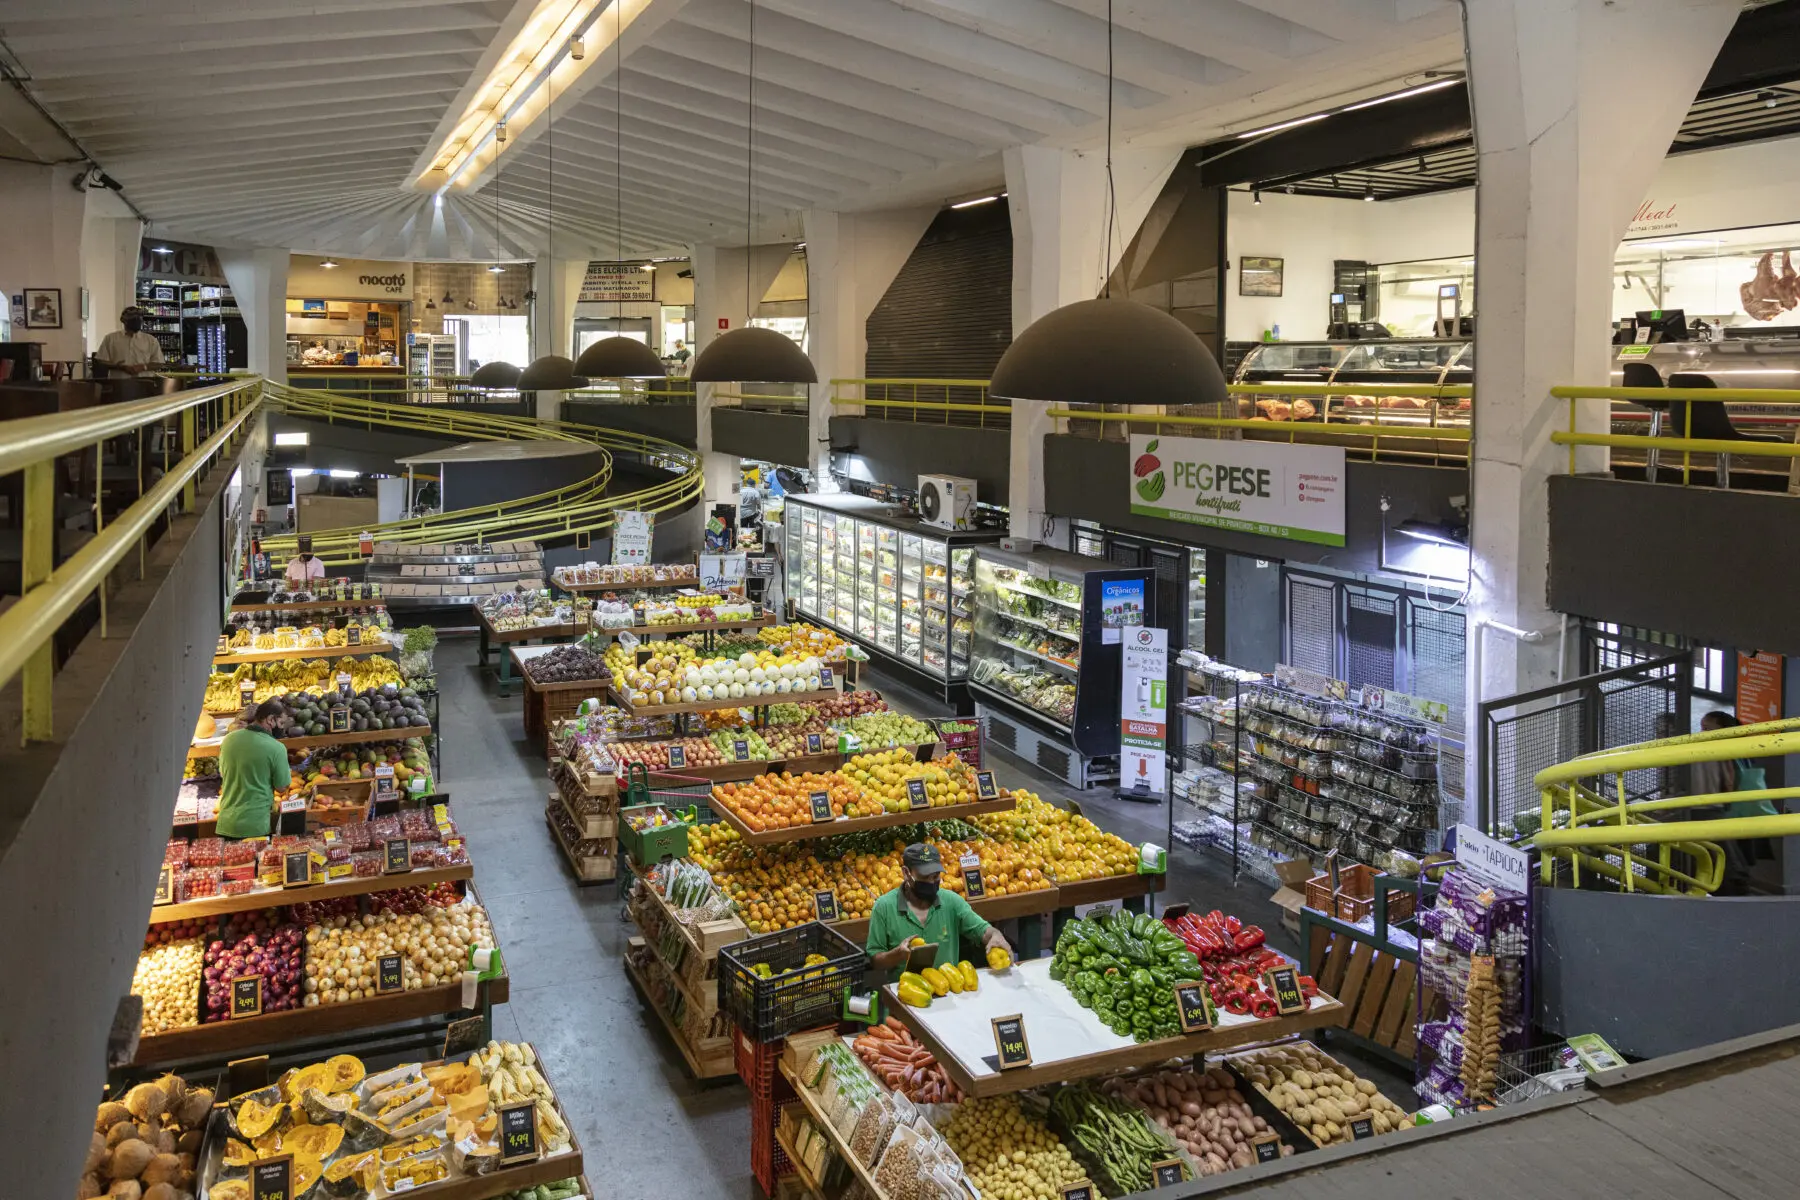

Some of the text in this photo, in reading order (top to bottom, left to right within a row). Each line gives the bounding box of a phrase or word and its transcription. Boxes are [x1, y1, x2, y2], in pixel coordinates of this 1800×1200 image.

[359, 273, 406, 286] mocotó
[1173, 460, 1271, 498] PEGPESE
[1195, 491, 1241, 514] hortifruti
[1106, 585, 1140, 597] Orgânicos
[1129, 724, 1158, 734] BATALHA
[1124, 737, 1162, 748] PROTEJA-SE
[283, 801, 304, 809] OFERTA
[1187, 1008, 1202, 1019] 6,99
[1005, 1041, 1023, 1053] 14,99
[509, 1133, 529, 1147] 4,99
